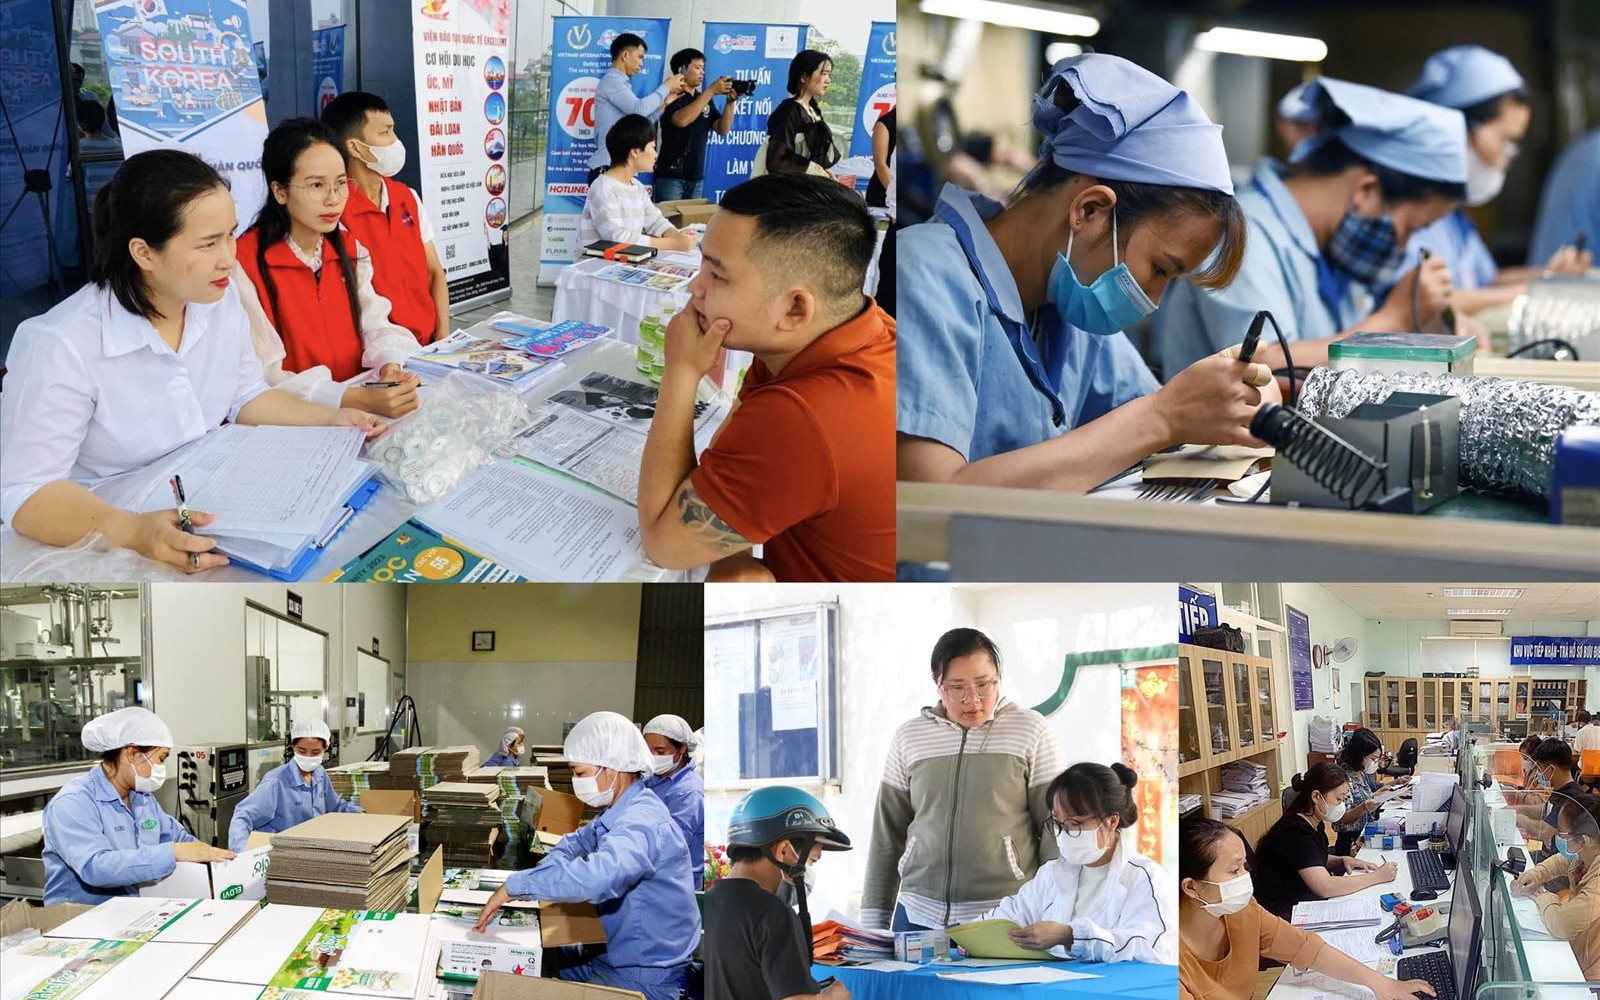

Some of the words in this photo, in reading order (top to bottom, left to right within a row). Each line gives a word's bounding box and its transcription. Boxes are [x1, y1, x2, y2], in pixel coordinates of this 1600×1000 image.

[140, 39, 226, 66] SOUTH
[439, 50, 451, 68] HỘI
[453, 55, 461, 66] DU
[462, 55, 475, 70] HỌC
[144, 66, 232, 90] KOREA
[750, 66, 771, 85] VẤN
[428, 98, 448, 115] NHẬT
[734, 96, 753, 115] KẾT
[755, 96, 772, 115] NỐI
[445, 123, 460, 136] LOAN
[727, 158, 748, 175] LÀM
[429, 557, 450, 570] 55
[196, 751, 205, 760] 05
[222, 886, 242, 899] ELOVI
